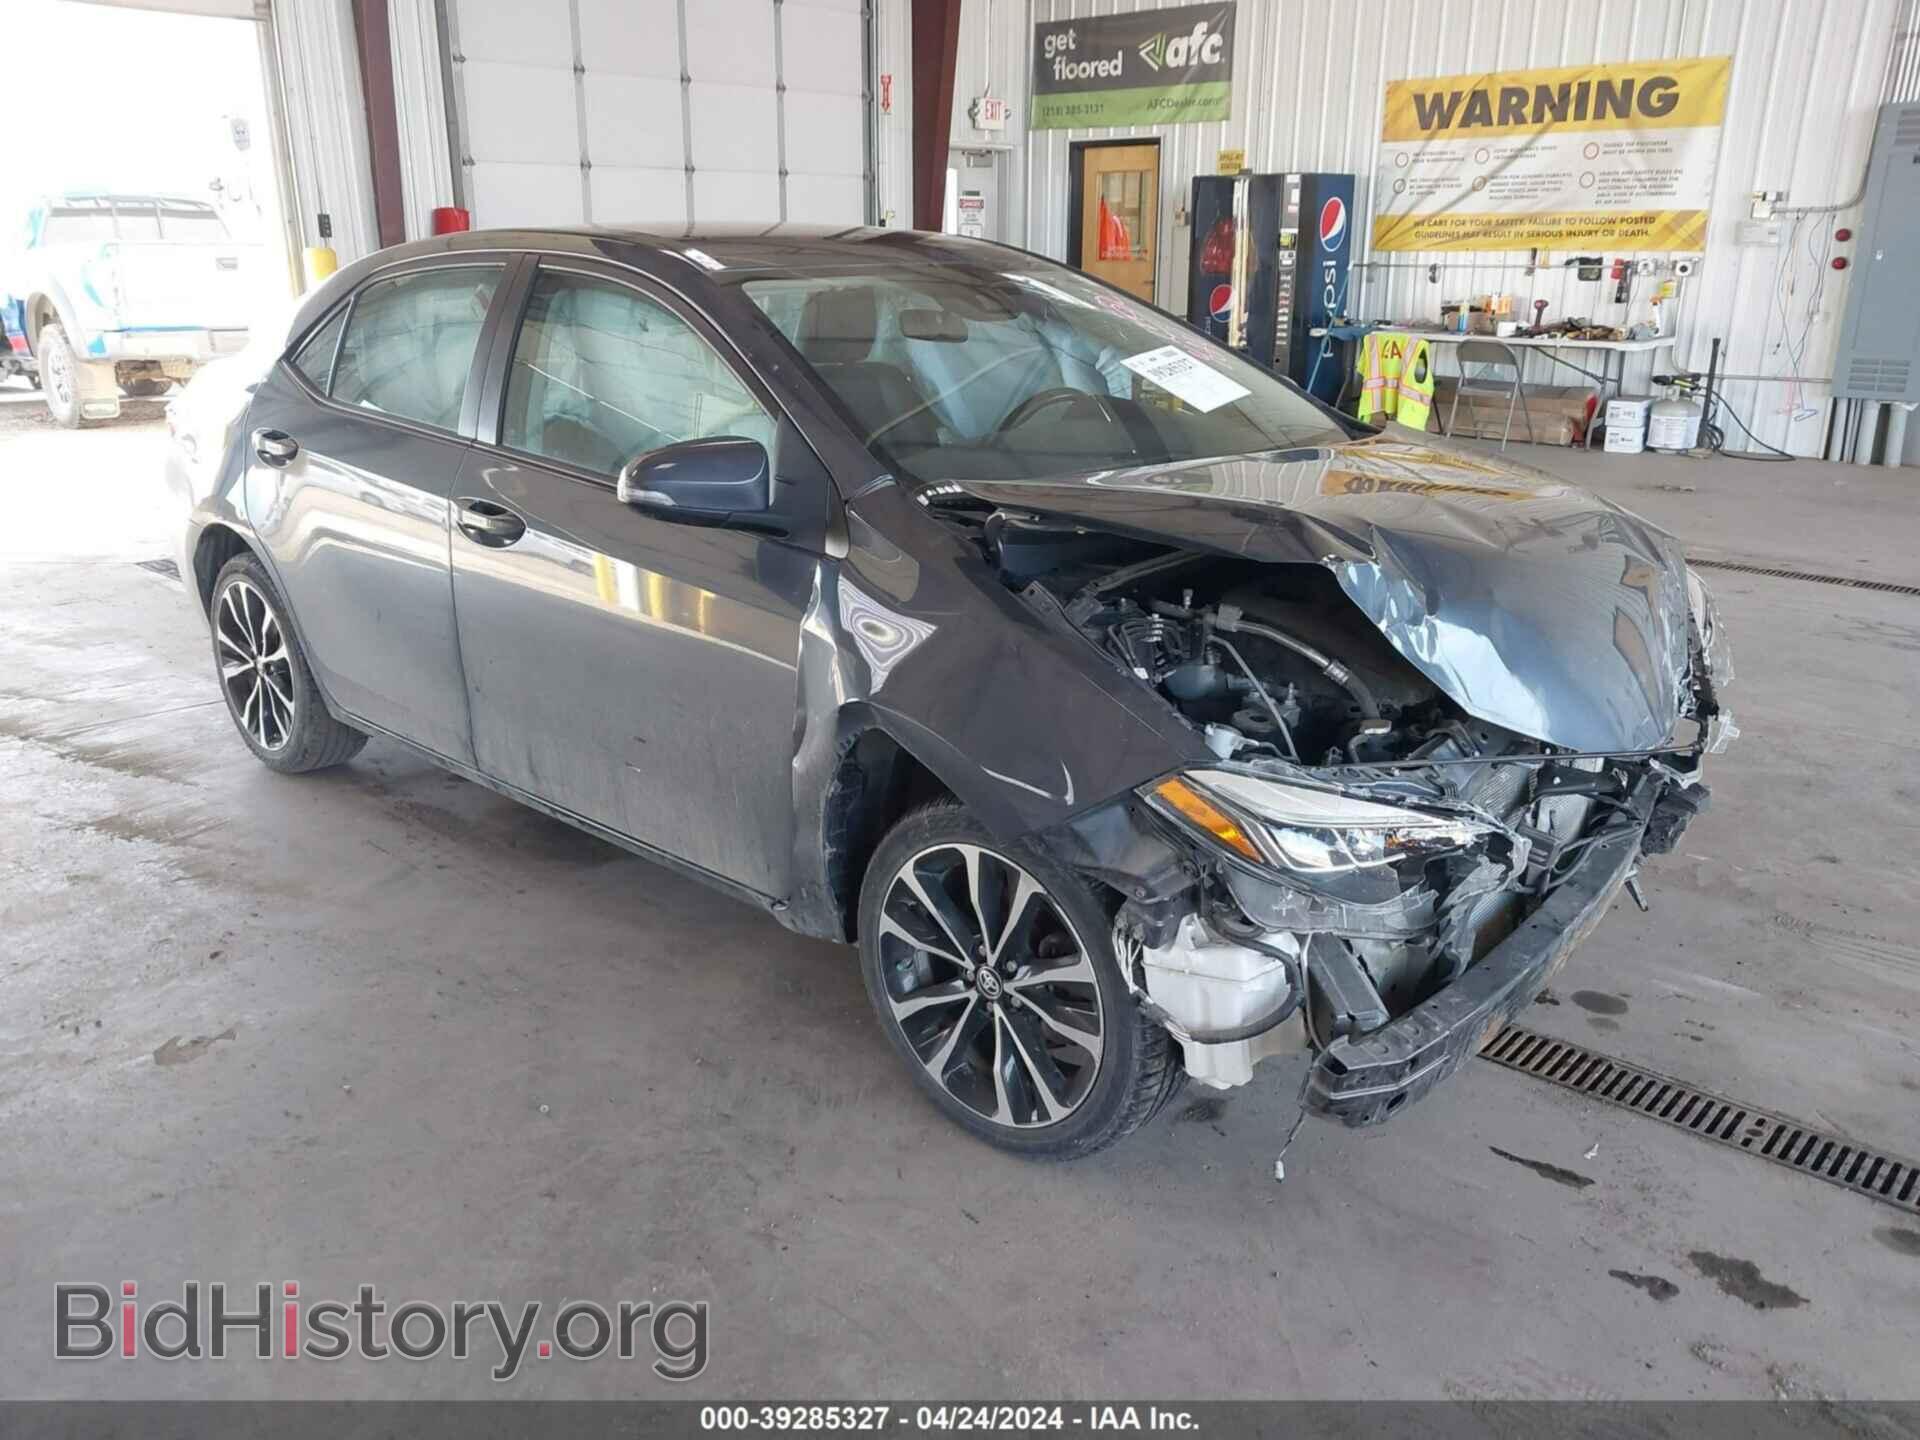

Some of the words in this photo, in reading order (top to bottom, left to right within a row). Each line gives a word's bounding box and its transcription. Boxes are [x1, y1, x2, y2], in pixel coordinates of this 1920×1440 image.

[1044, 28, 1077, 59] get
[1165, 21, 1224, 68] afc
[1053, 50, 1123, 81] floored
[985, 99, 1002, 120] EXIT
[1413, 75, 1680, 131] WARNING
[1469, 218, 1491, 226] YOUR
[1578, 216, 1616, 224] FOLLOW
[1620, 215, 1655, 224] POSTED
[1482, 230, 1511, 238] RESULT
[1566, 229, 1598, 237] INJURY
[1602, 229, 1614, 237] OR
